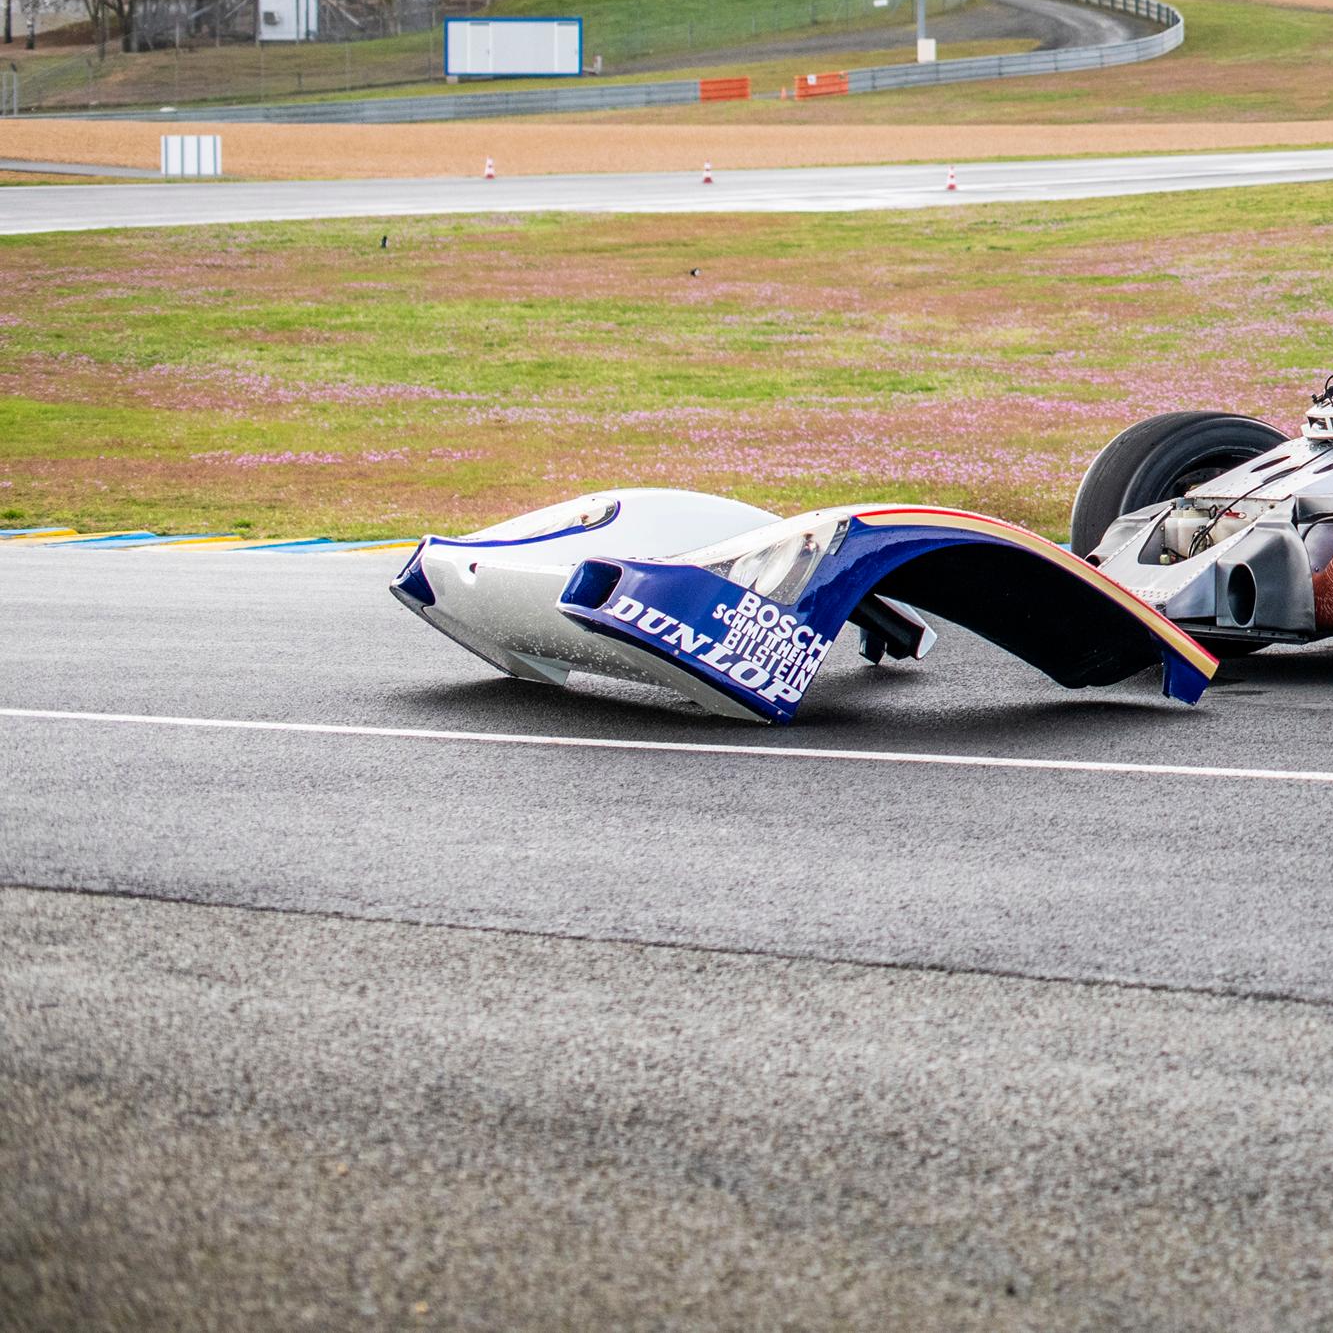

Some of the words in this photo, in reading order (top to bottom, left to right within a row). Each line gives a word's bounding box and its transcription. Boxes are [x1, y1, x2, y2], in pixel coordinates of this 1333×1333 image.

[603, 595, 802, 703] DUNLOP
[712, 603, 821, 675] SCHMITTHELM
[723, 629, 813, 693] BILSTEIN
[736, 591, 833, 661] BOSCH
